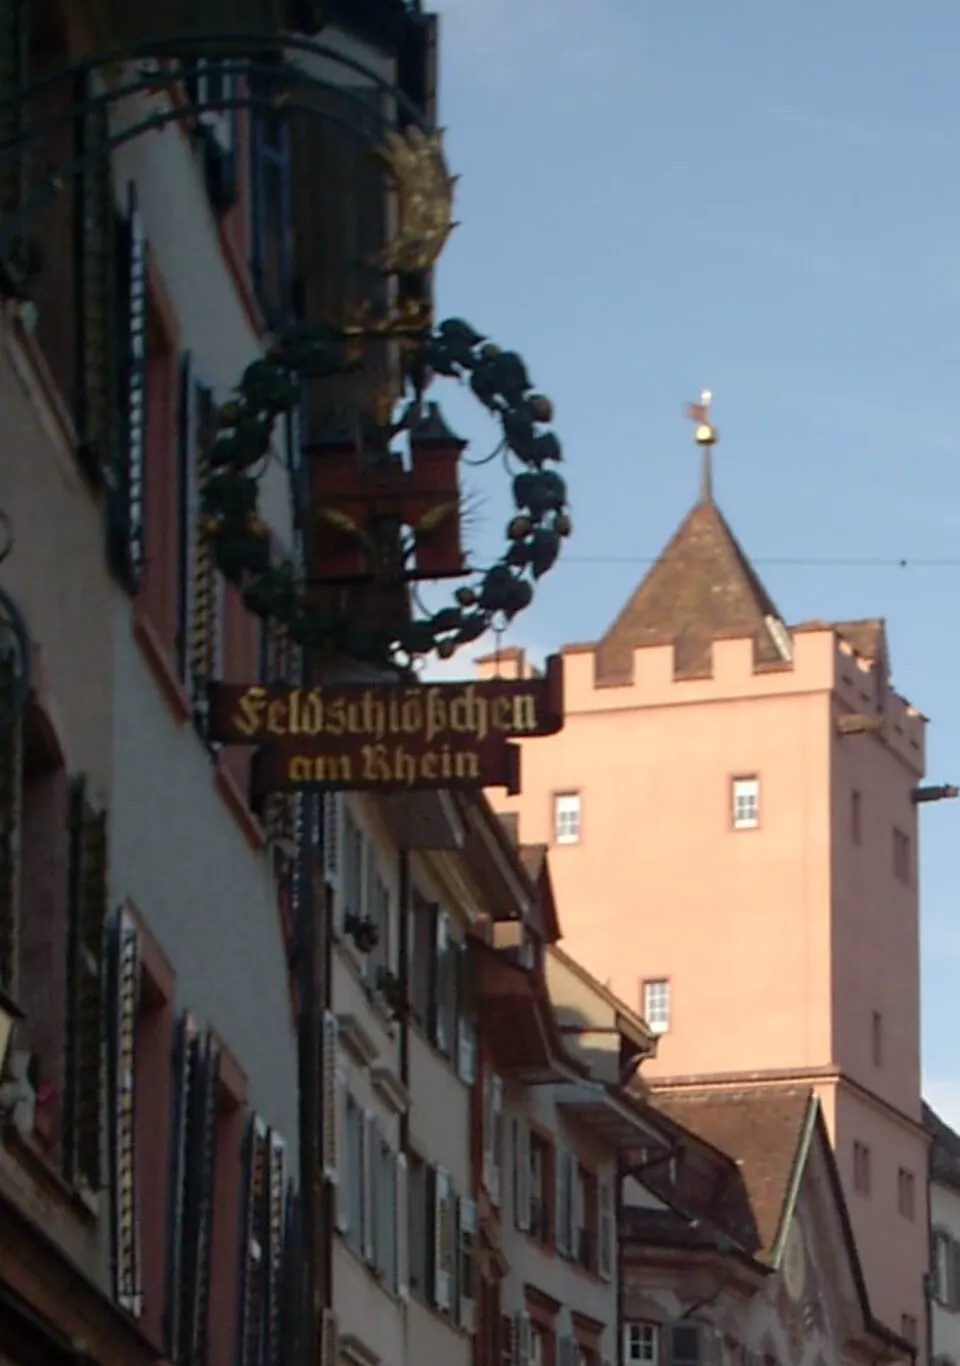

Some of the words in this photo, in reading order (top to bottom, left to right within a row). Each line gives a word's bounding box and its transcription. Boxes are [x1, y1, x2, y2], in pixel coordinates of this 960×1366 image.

[232, 684, 537, 742] Feldschlößchen
[287, 752, 353, 783] am
[360, 743, 481, 786] Rhein
